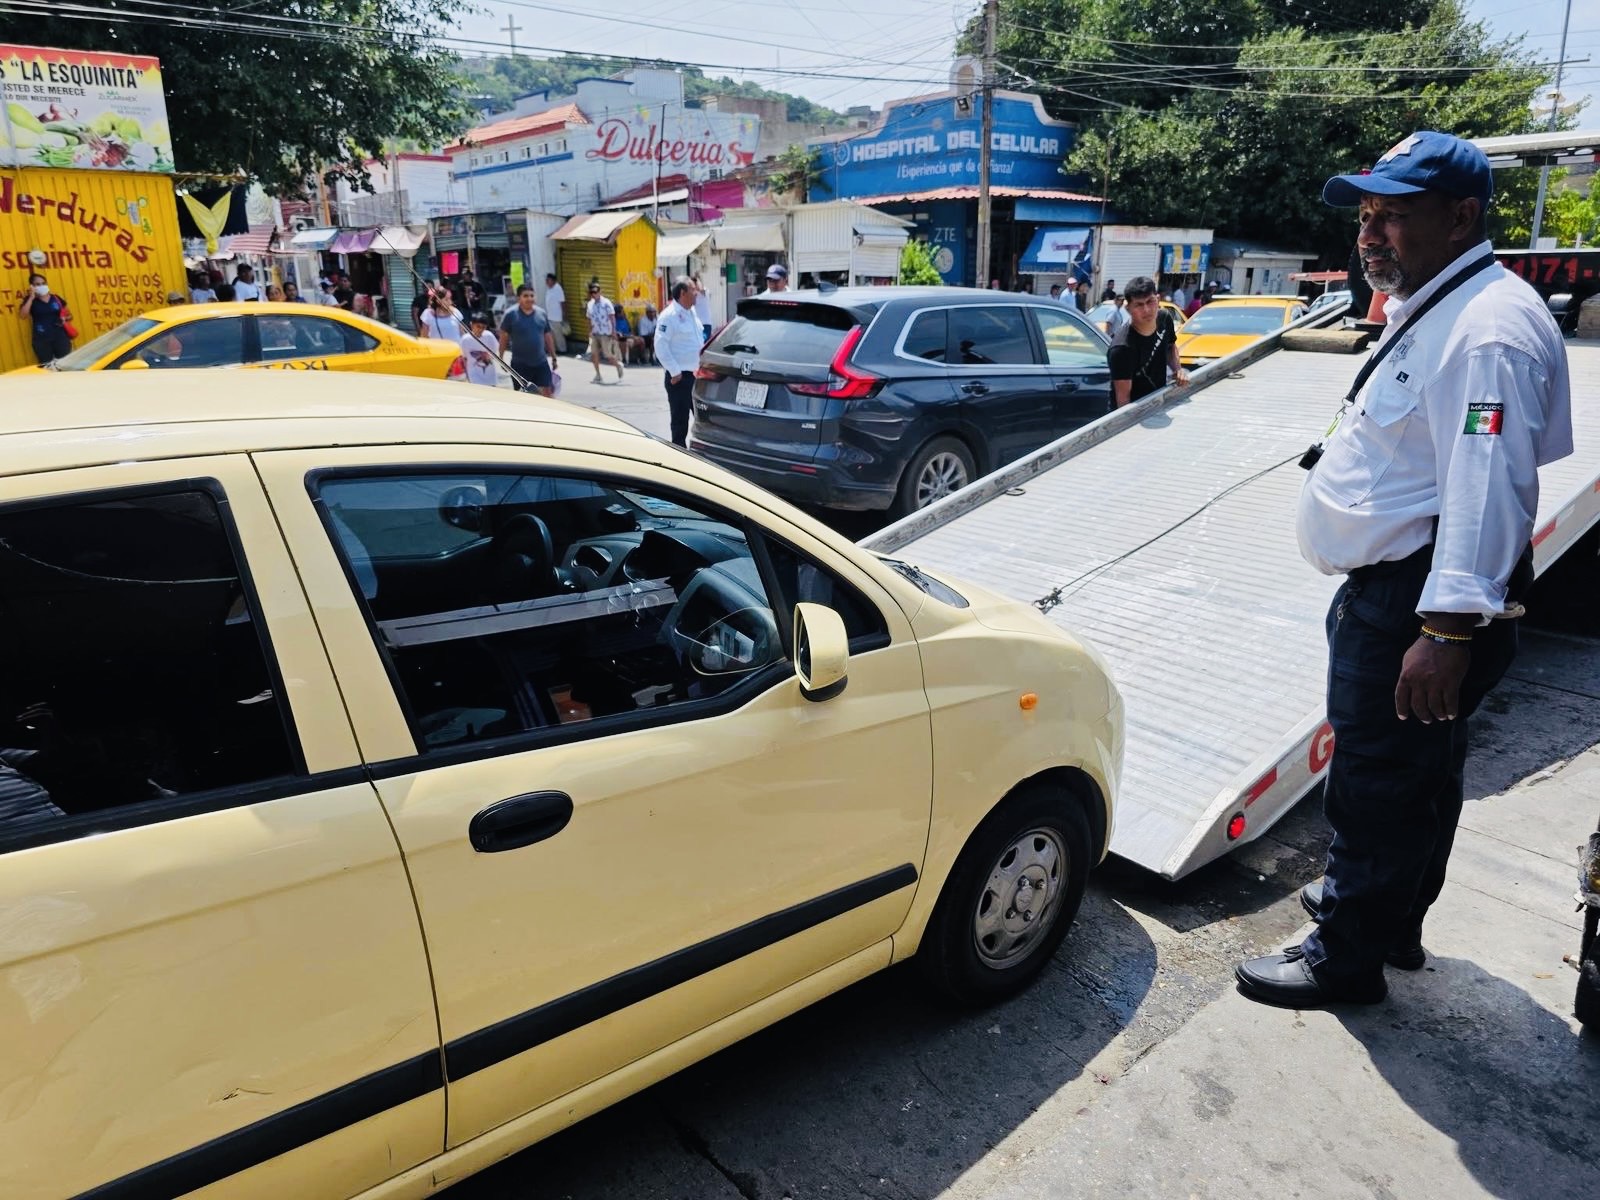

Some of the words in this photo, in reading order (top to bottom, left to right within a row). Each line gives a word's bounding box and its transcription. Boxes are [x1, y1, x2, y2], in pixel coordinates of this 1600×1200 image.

[33, 85, 45, 94] SE
[48, 86, 86, 97] MERECE
[853, 135, 941, 162] HOSPITAL
[946, 130, 982, 150] DEL
[990, 132, 1059, 155] CELULAR
[949, 161, 963, 177] que
[934, 227, 957, 242] ZTE
